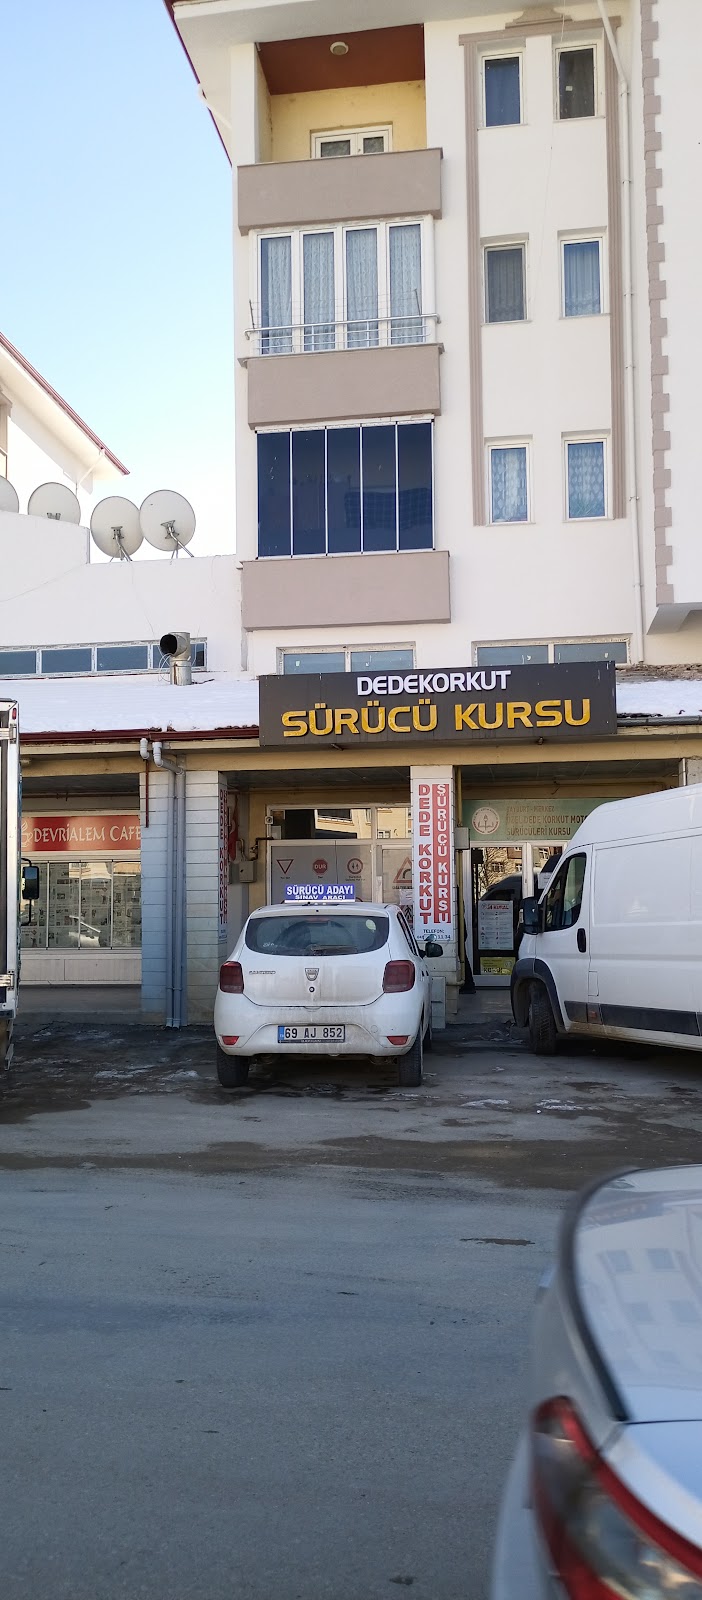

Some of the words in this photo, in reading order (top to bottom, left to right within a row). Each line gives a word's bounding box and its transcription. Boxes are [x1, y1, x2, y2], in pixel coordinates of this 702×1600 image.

[356, 670, 511, 696] DEDEKORKUT
[281, 698, 438, 737] SÜRÜCÜ
[455, 698, 591, 731] KURSU
[418, 784, 431, 837] DEDE
[436, 784, 447, 857] SÜRÜCÜ
[542, 815, 569, 824] KORKUT
[33, 824, 105, 843] DEVRİALEM
[109, 825, 141, 842] CAFE
[549, 828, 571, 836] KURSU
[286, 885, 324, 895] SÜRÜCÜ
[326, 885, 353, 894] ADAYI
[418, 844, 433, 925] KORKUT
[437, 862, 449, 923] KURSU
[285, 1028, 297, 1038] 69
[304, 1027, 316, 1038] AJ
[323, 1027, 342, 1038] 852
